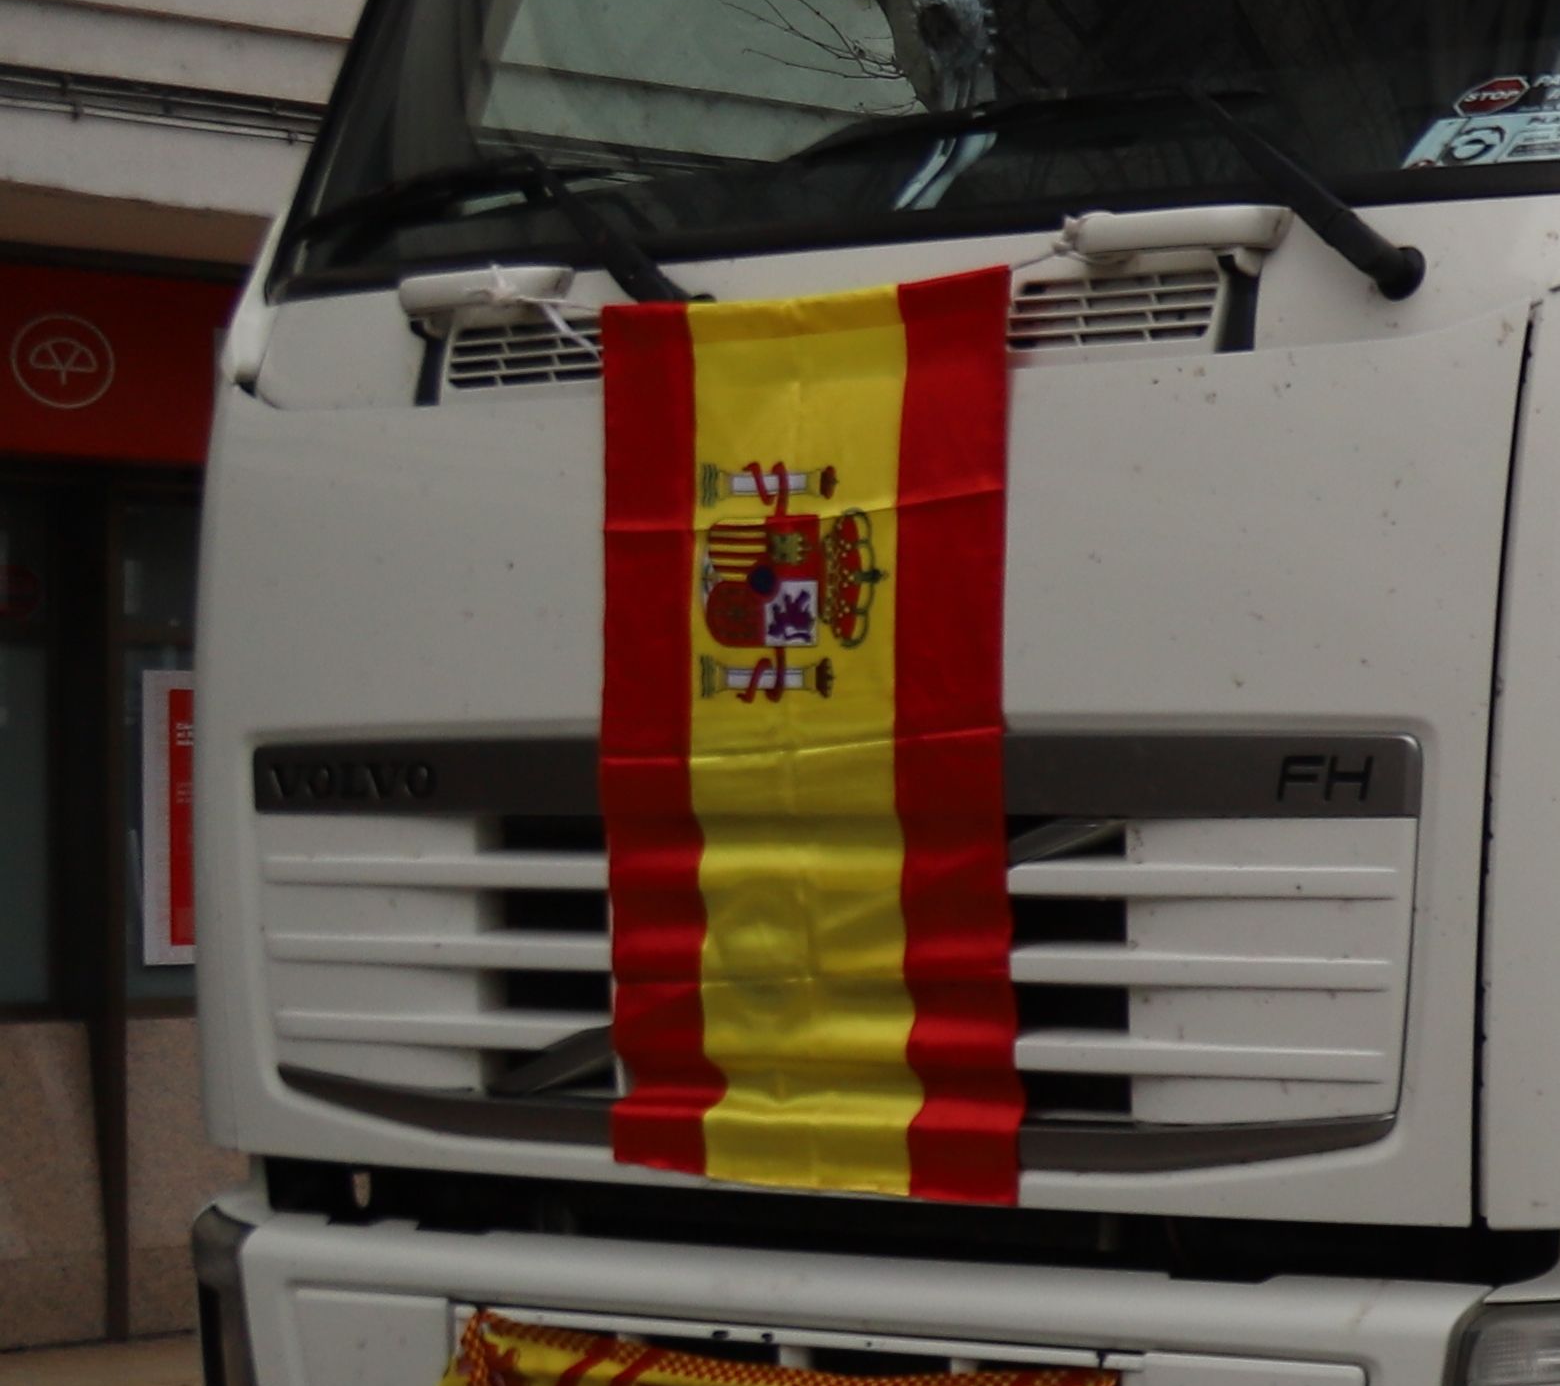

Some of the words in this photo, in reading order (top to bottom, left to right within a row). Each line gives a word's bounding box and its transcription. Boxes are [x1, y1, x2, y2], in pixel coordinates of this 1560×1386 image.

[1463, 90, 1520, 102] STOP
[268, 761, 437, 800] VOLVO
[1276, 753, 1374, 802] FH
